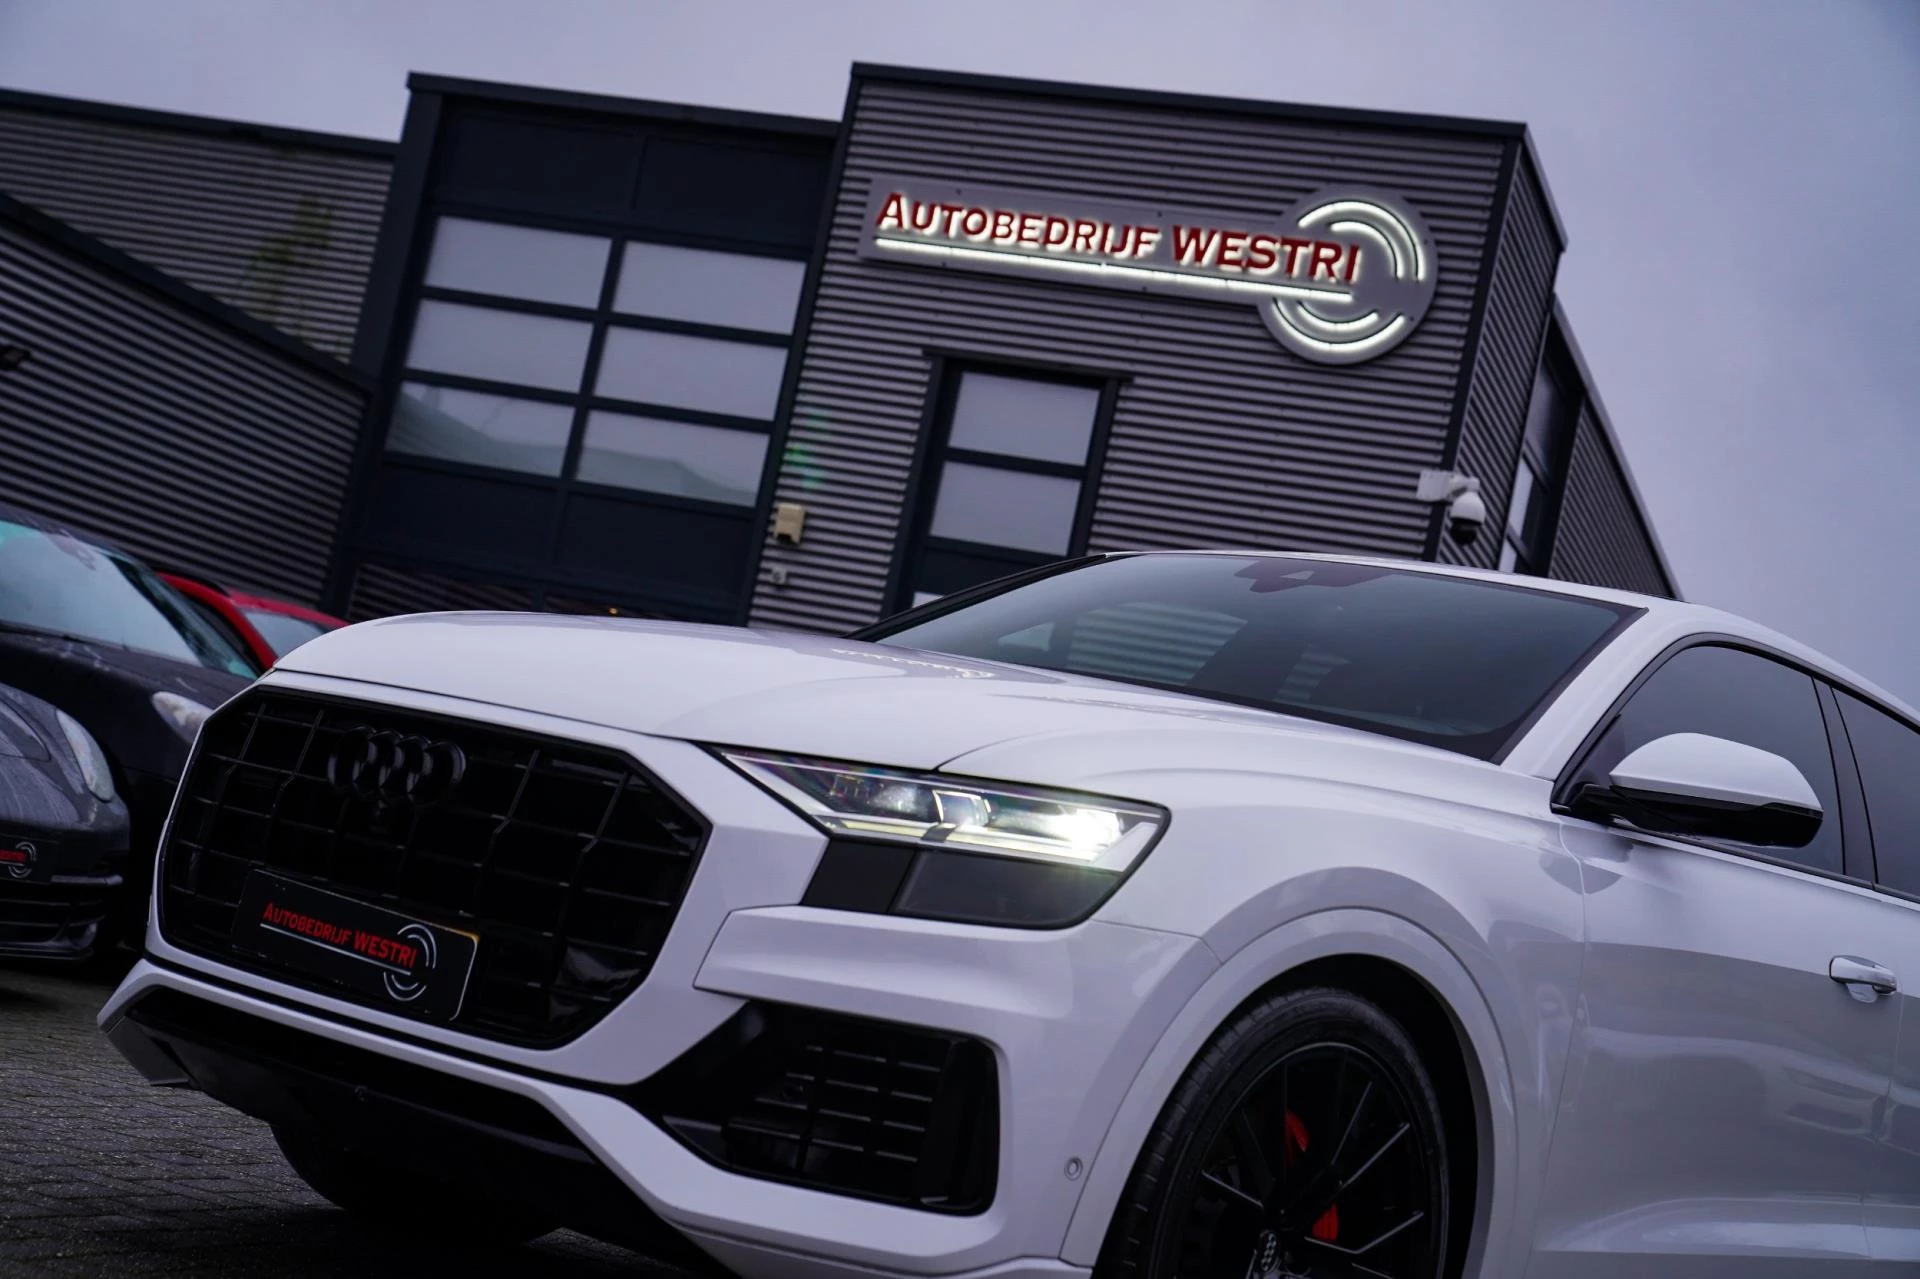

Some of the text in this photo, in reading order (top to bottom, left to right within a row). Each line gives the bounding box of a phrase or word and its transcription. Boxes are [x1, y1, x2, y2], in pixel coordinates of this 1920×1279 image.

[876, 192, 1360, 284] AUTOBEDRIJF WESTRI
[263, 903, 417, 968] AUTOBEDRIJF WESTRI
